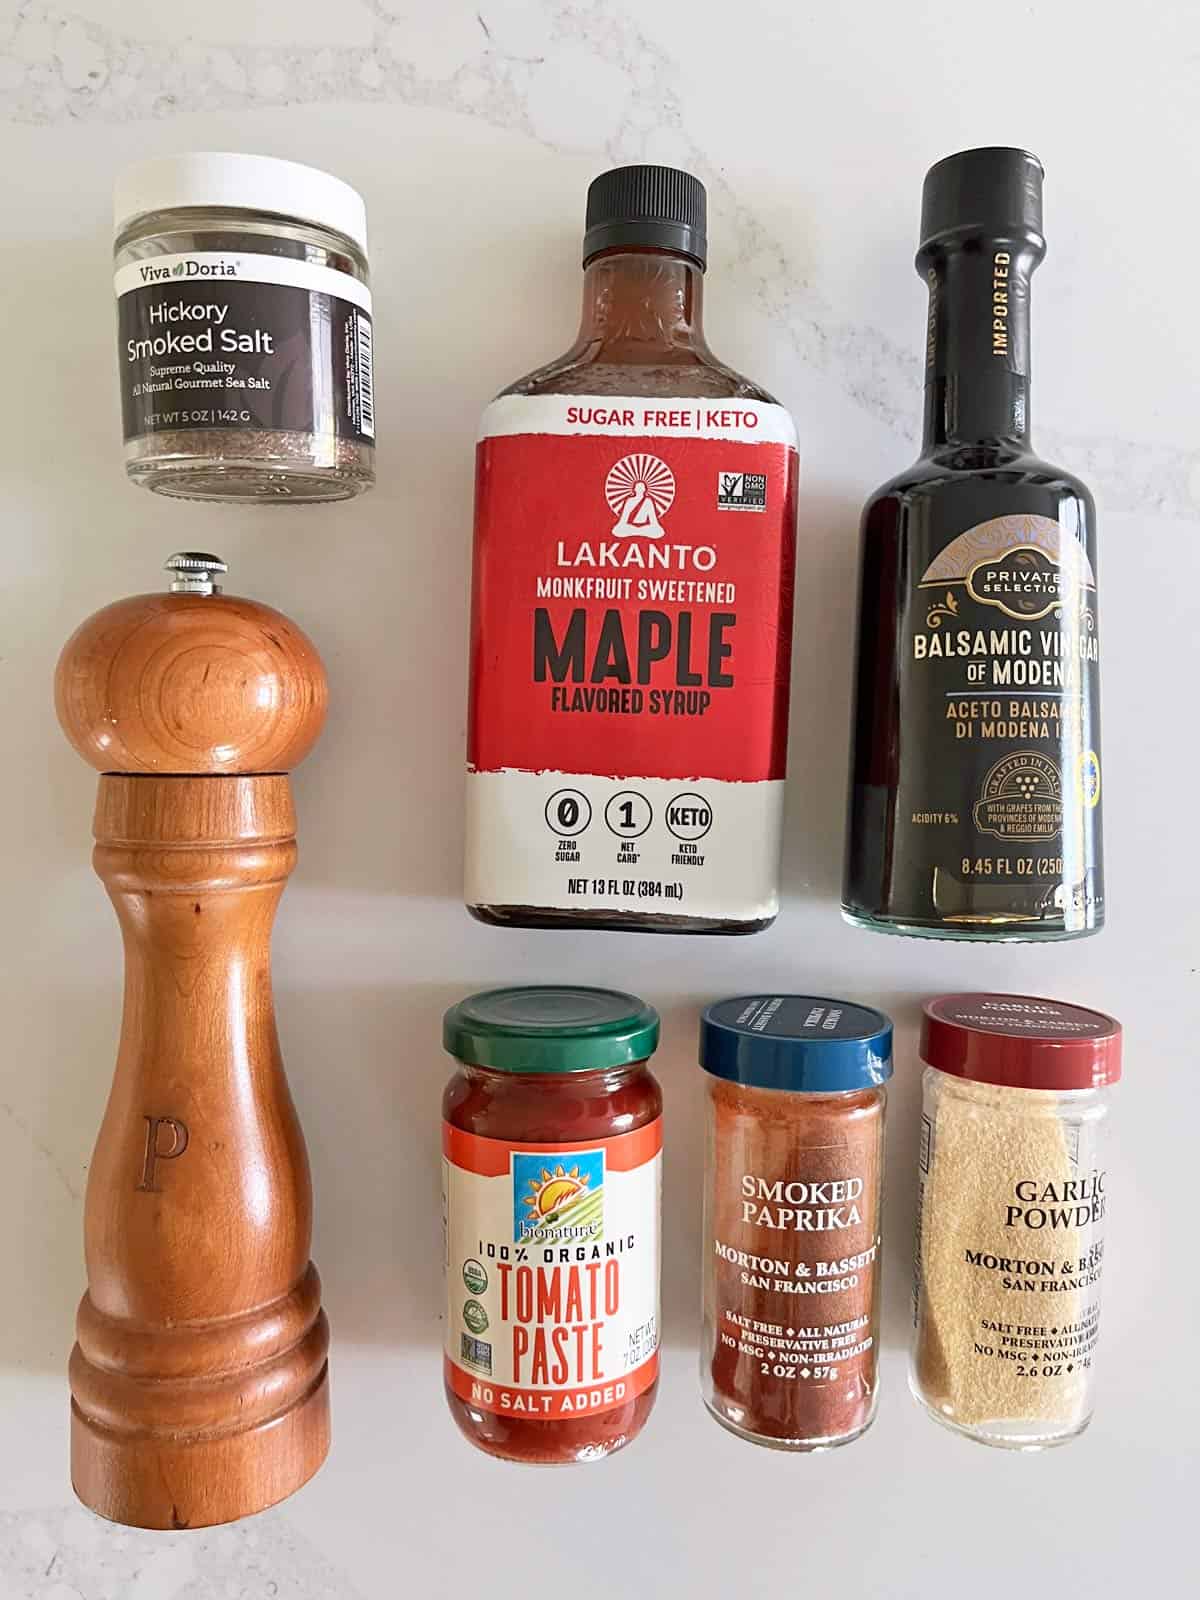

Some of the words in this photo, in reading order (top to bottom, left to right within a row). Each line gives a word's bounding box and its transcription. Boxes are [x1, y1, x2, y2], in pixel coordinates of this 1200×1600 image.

[140, 265, 170, 281] Viva
[149, 301, 228, 324] Hickory
[993, 252, 1010, 355] IMPORTED
[127, 328, 212, 361] Smoked
[220, 329, 274, 354] Salt
[150, 365, 191, 377] Supreme
[193, 361, 235, 375] Quality
[132, 384, 141, 396] All
[142, 379, 172, 394] Natural
[174, 378, 224, 389] Gourmet
[225, 377, 246, 388] Sea
[248, 377, 271, 390] Salt
[144, 413, 161, 425] NET
[162, 412, 180, 423] WT
[182, 411, 189, 421] 5
[191, 410, 209, 422] OZ
[218, 410, 238, 421] 142
[240, 411, 251, 421] G
[567, 407, 634, 425] SUGAR
[643, 410, 691, 427] FREE
[707, 410, 758, 428] KETO
[557, 541, 717, 571] LAKANTO
[986, 571, 1062, 583] PRIVATE
[537, 577, 633, 599] MONKFRUIT
[638, 579, 736, 603] SWEETENED
[533, 607, 737, 688] MAPLE
[914, 629, 1032, 659] BALSAMIC
[1040, 630, 1098, 661] VINGAR
[967, 664, 987, 681] OF
[551, 687, 643, 713] FLAVORED
[649, 690, 711, 715] SYRUP
[945, 701, 1001, 719] ACETO
[956, 721, 973, 738] DI
[981, 721, 1049, 738] MODENA
[989, 757, 1028, 794] CRAFTED
[1031, 757, 1042, 768] IN
[557, 798, 579, 827] 0
[619, 801, 636, 828] 1
[670, 807, 709, 826] KETO
[987, 803, 1005, 812] WITH
[1006, 803, 1033, 813] GRAPES
[1034, 803, 1051, 813] FROM
[911, 813, 943, 824] ACIDITY
[944, 813, 959, 824] 6%
[987, 814, 1027, 823] PROVINCES
[1007, 824, 1032, 833] REGGIO
[1033, 824, 1054, 833] EMILIA
[558, 840, 577, 850] ZERO
[621, 842, 635, 852] NET
[679, 844, 697, 854] KETO
[555, 852, 581, 862] SUGAR
[671, 855, 705, 866] FRIENDLY
[961, 858, 992, 874] 8.45
[997, 858, 1012, 874] FL
[1017, 858, 1033, 874] OZ
[568, 879, 589, 895] NET
[591, 879, 605, 894] 13
[608, 880, 620, 895] FL
[623, 880, 636, 896] OZ
[638, 880, 662, 898] (384
[665, 882, 683, 900] mL)
[136, 1116, 188, 1192] P
[742, 1175, 863, 1204] SMOKED
[741, 1200, 862, 1231] PAPRIKA
[479, 1240, 529, 1262] 100%
[543, 1235, 635, 1264] ORGANIC
[714, 1239, 789, 1276] MORTON
[795, 1262, 811, 1277] &
[816, 1245, 877, 1276] BASSETT
[964, 1249, 1055, 1275] MORTON
[1060, 1260, 1074, 1275] &
[497, 1258, 620, 1325] TOMATO
[741, 1272, 770, 1289] SAN
[774, 1275, 858, 1294] FRANCISCO
[1002, 1277, 1036, 1292] SAN
[725, 1310, 750, 1328] SALT
[753, 1320, 783, 1336] FREE
[798, 1327, 821, 1338] ALL
[824, 1314, 870, 1336] NATURAL
[981, 1319, 1013, 1334] SALT
[1016, 1325, 1047, 1336] FREE
[721, 1333, 736, 1348] NO
[738, 1343, 764, 1358] MSG
[779, 1336, 873, 1363] NON-IRRADIATED
[741, 1330, 829, 1350] PRESERVATIVE
[832, 1332, 857, 1349] FREE
[512, 1321, 605, 1386] PASTE
[974, 1343, 993, 1356] NO
[997, 1350, 1027, 1362] MSG
[761, 1363, 769, 1375] 2
[773, 1364, 796, 1379] OZ
[813, 1366, 839, 1381] 57g
[1016, 1365, 1038, 1377] 2.6
[1042, 1365, 1063, 1377] OZ
[471, 1382, 494, 1404] NO
[500, 1393, 553, 1412] SALT
[560, 1382, 626, 1411] ADDED
